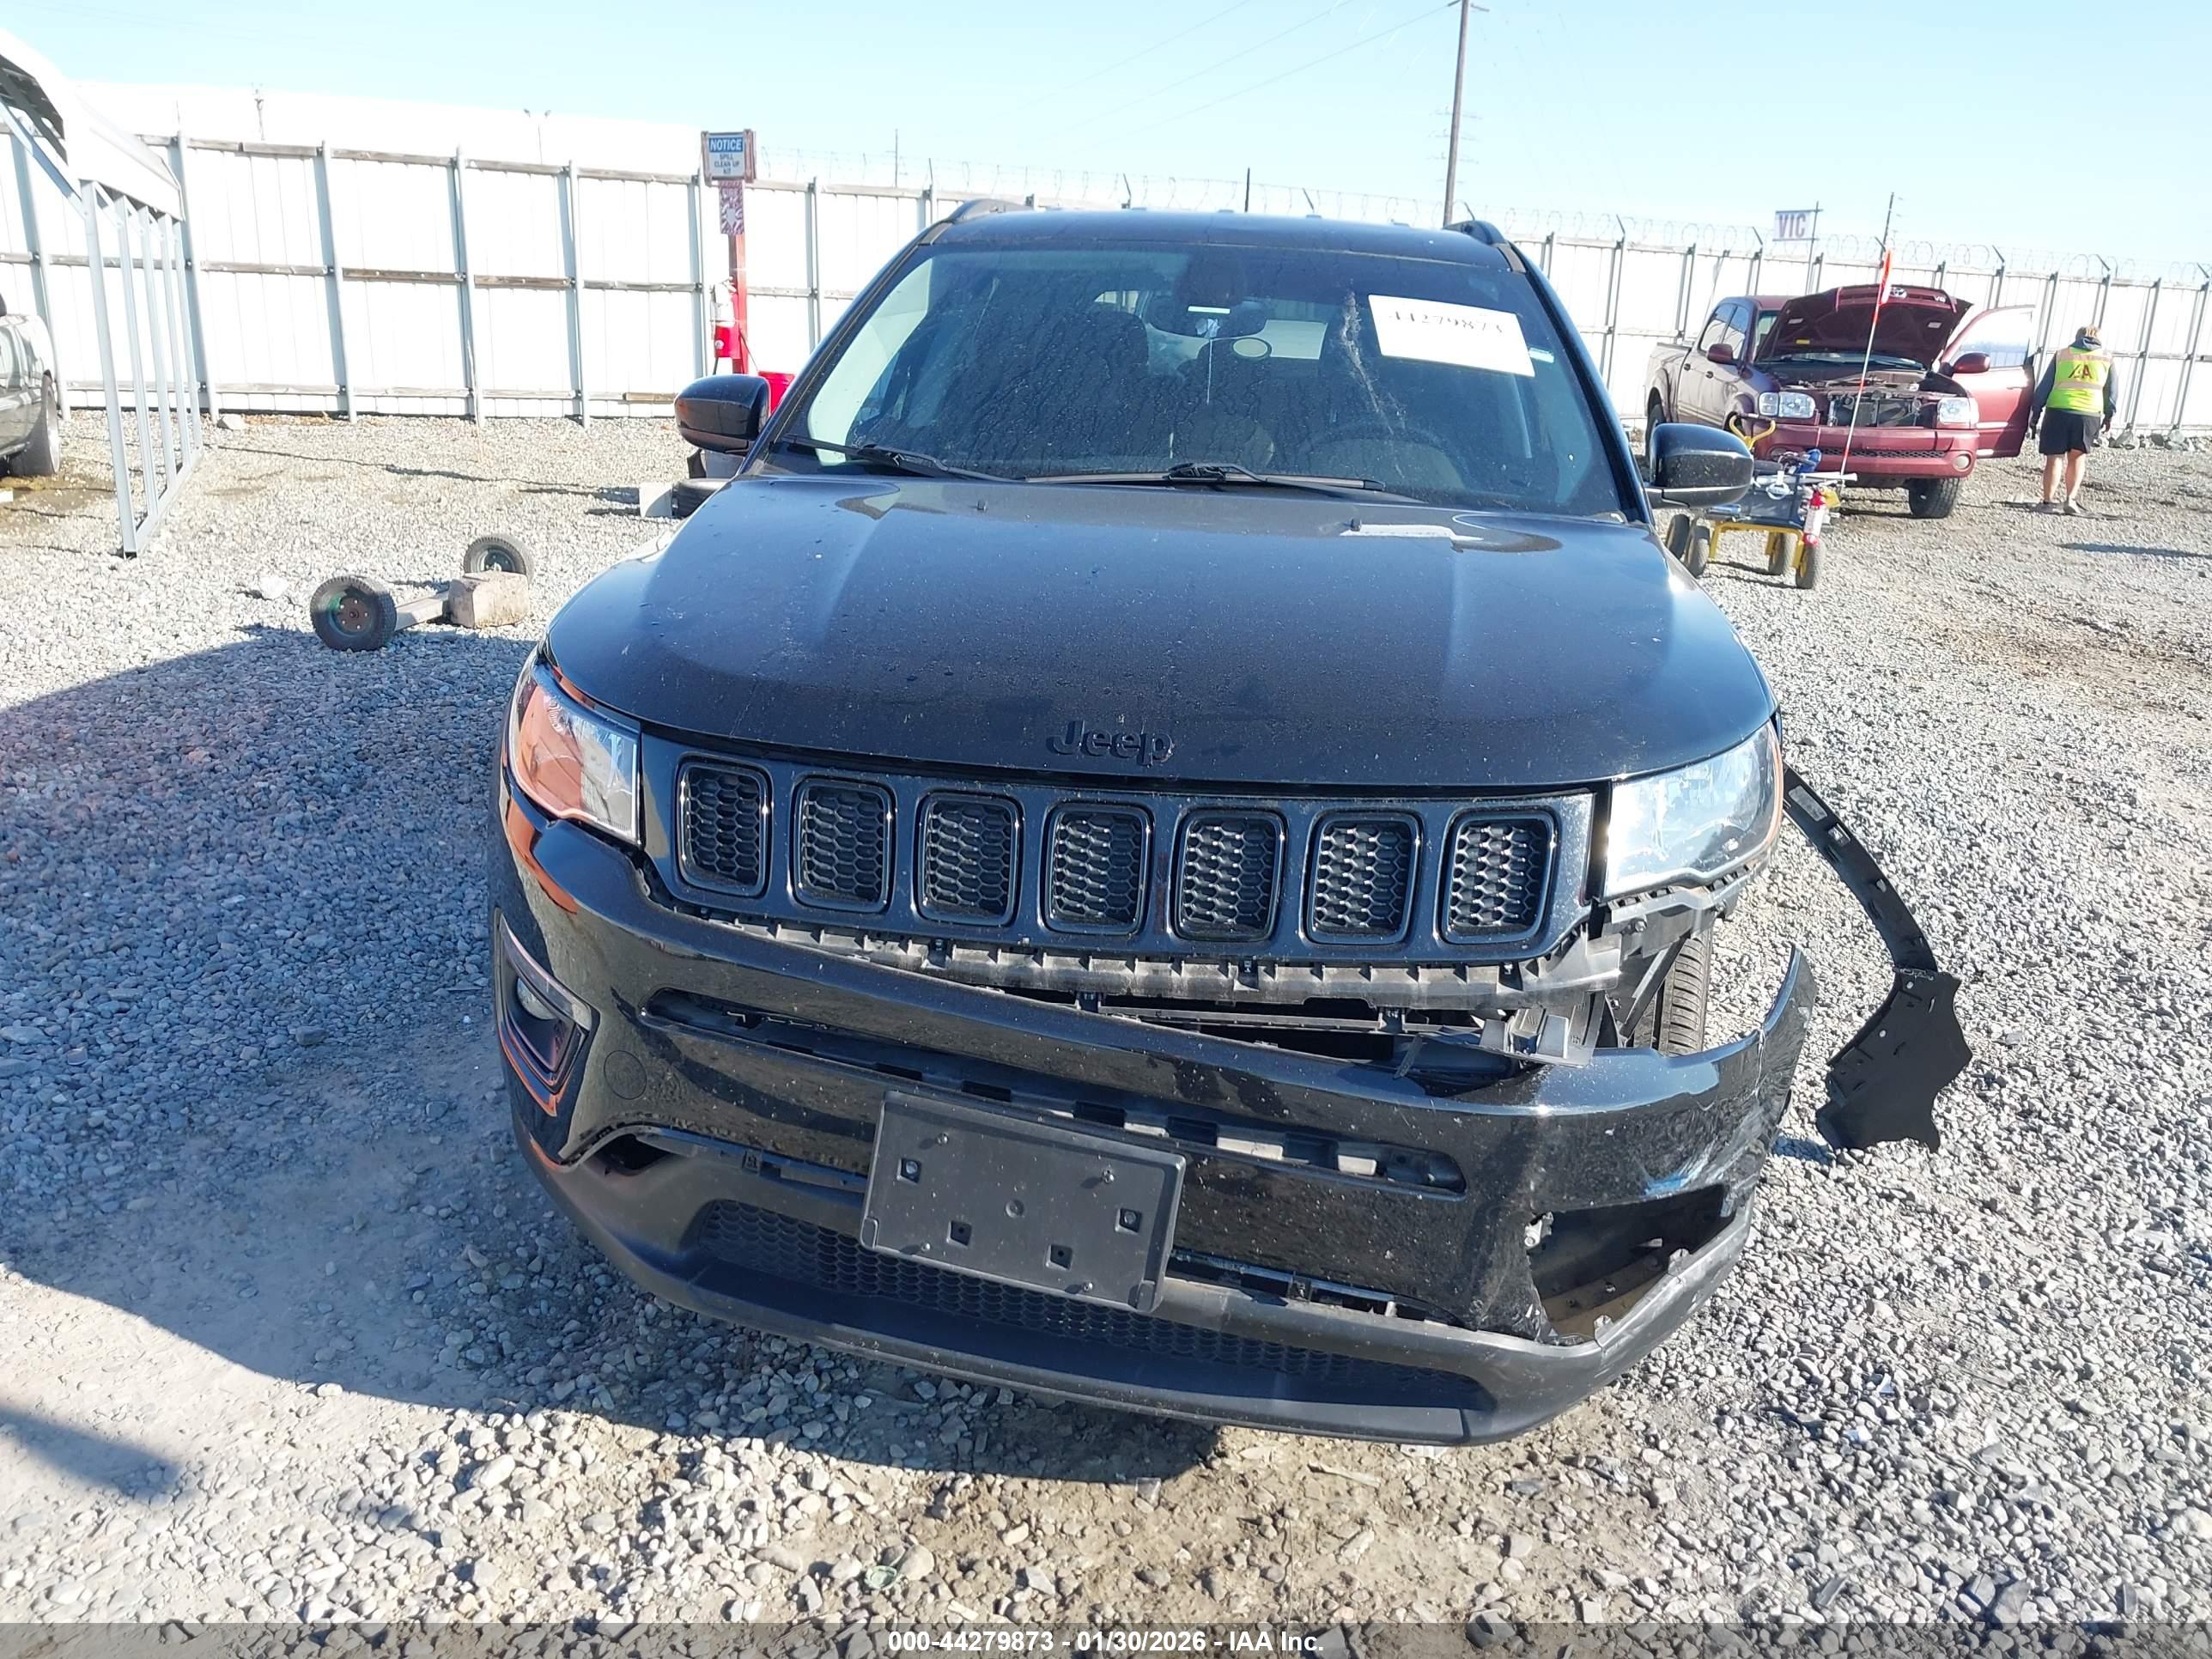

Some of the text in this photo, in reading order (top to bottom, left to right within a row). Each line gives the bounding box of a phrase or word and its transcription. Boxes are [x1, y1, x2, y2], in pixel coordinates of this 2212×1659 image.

[710, 138, 742, 151] NOTICE
[1779, 213, 1806, 238] VIC
[1047, 720, 1175, 766] Jeep
